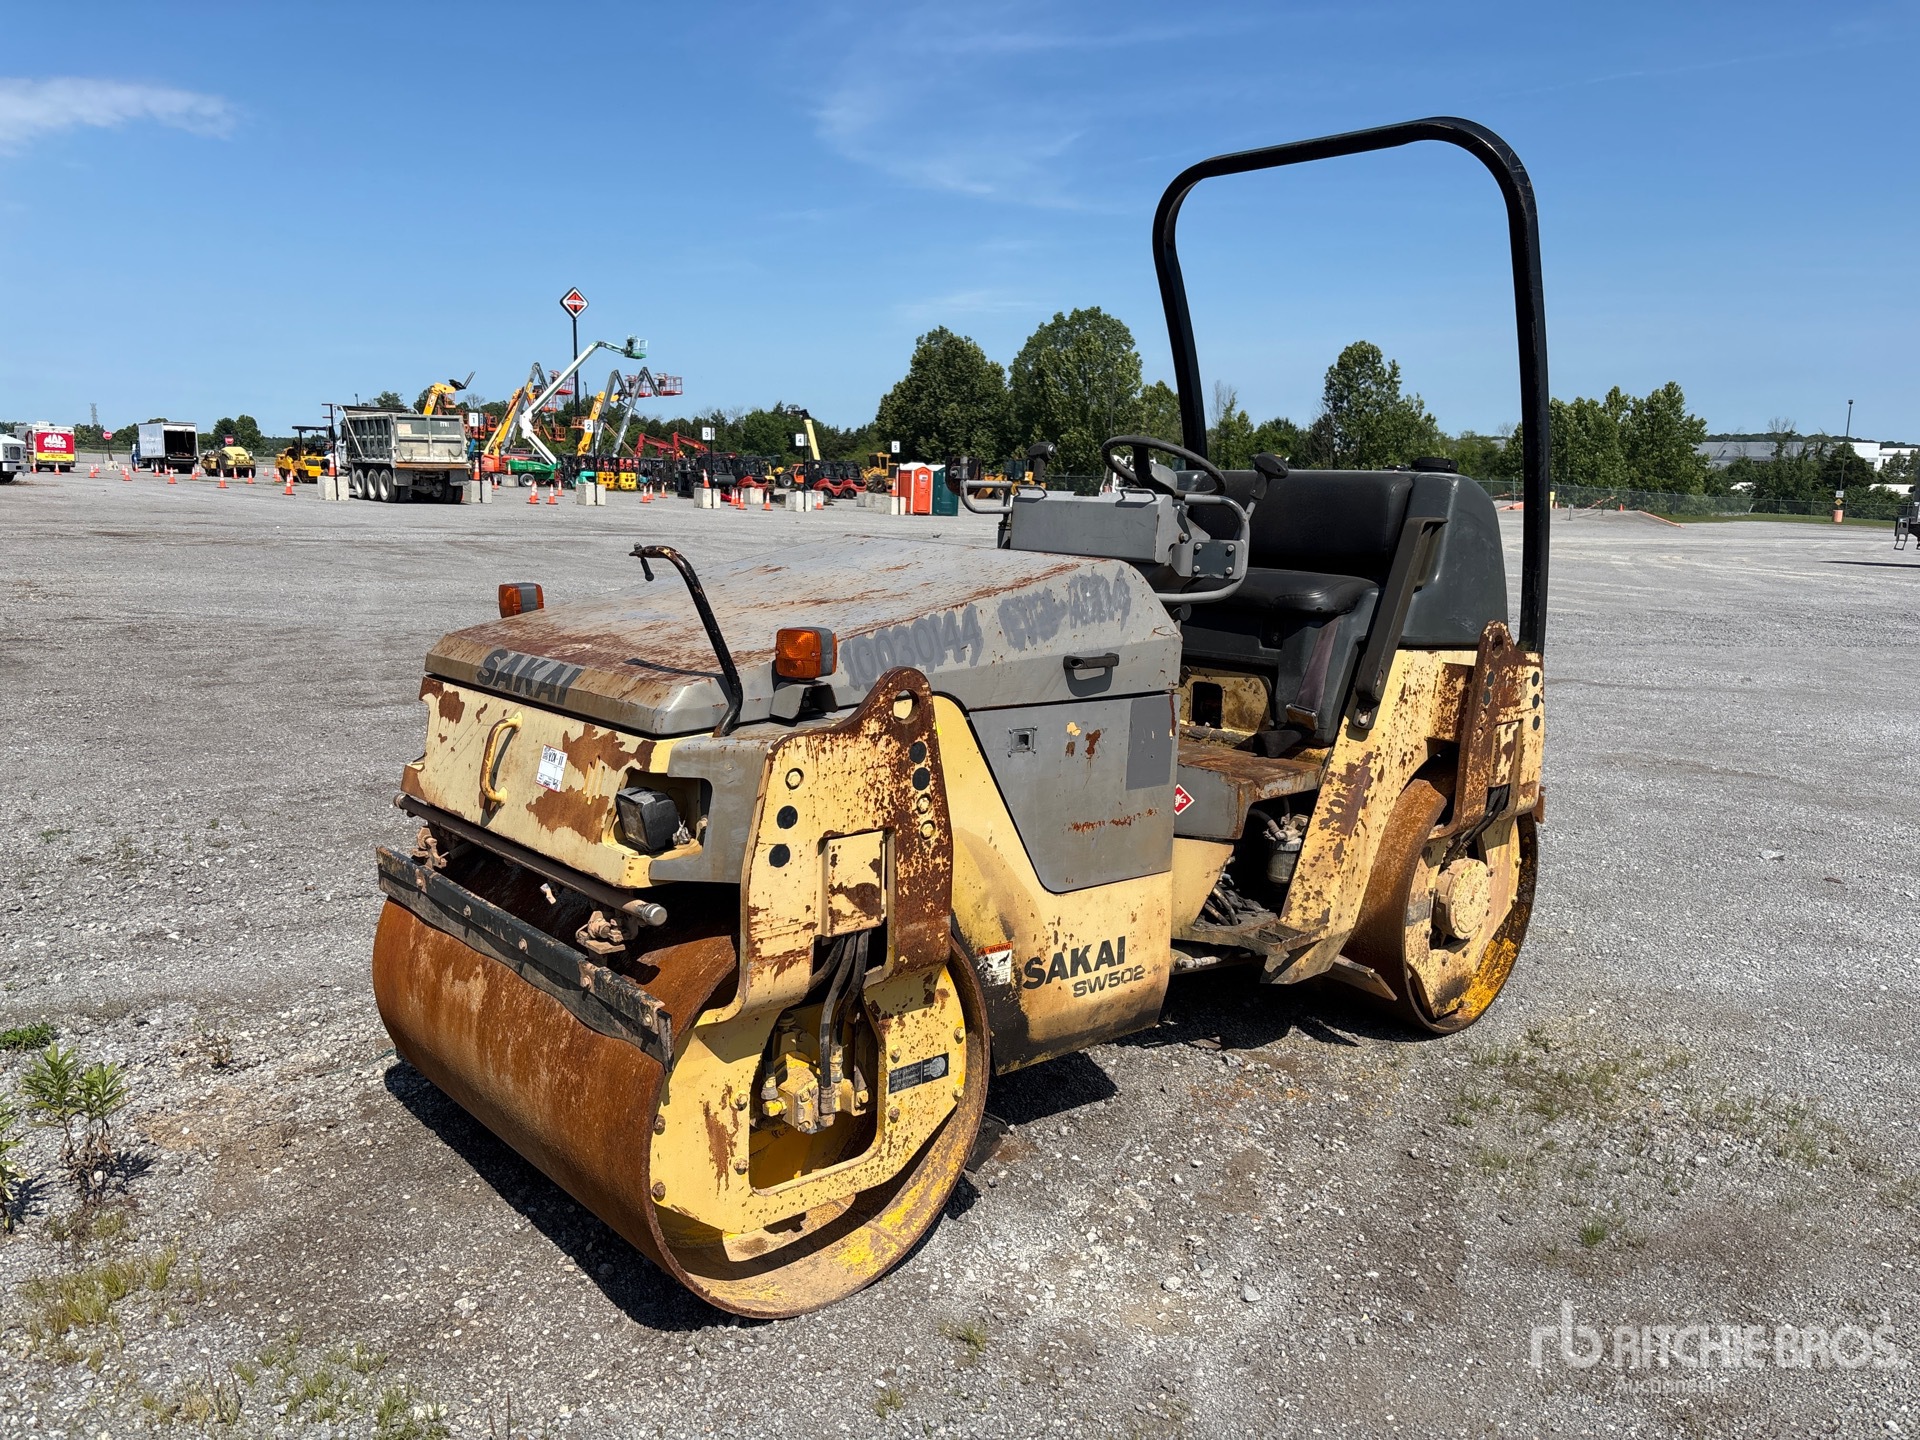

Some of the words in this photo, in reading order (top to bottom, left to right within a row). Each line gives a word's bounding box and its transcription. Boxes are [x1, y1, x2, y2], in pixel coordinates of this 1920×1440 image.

[476, 649, 585, 705] SAKAI
[1023, 936, 1126, 990] SAKAI
[1072, 964, 1146, 998] SW502
